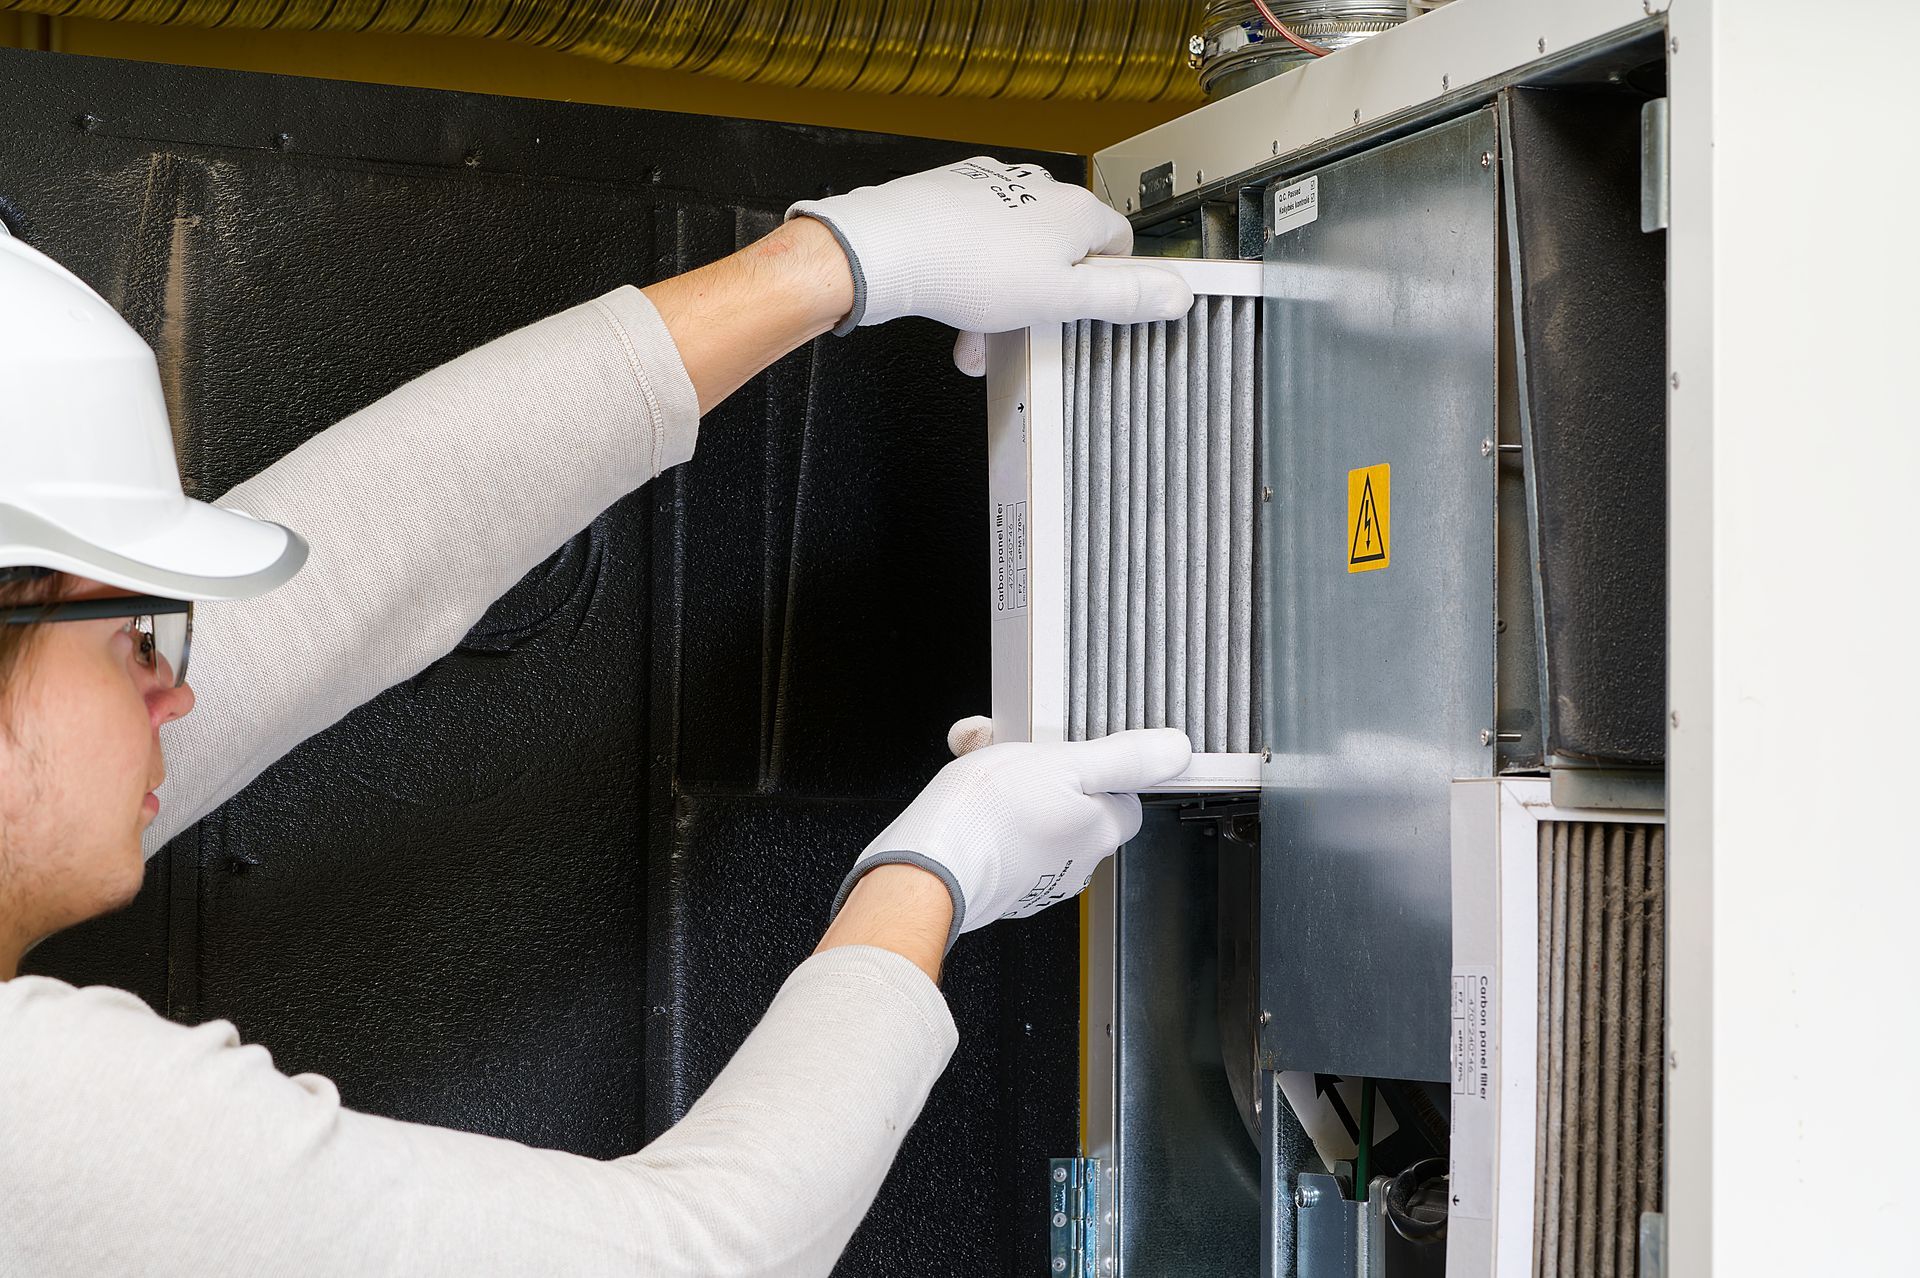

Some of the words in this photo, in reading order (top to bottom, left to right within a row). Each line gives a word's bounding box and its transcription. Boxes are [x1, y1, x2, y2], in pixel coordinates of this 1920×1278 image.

[1005, 166, 1033, 178] 11
[990, 185, 1012, 203] Cat
[1288, 187, 1301, 199] Passed
[997, 530, 1005, 563] panel
[1480, 976, 1488, 1026] Carbon
[1479, 1030, 1487, 1069] panel
[1480, 1072, 1488, 1100] filter
